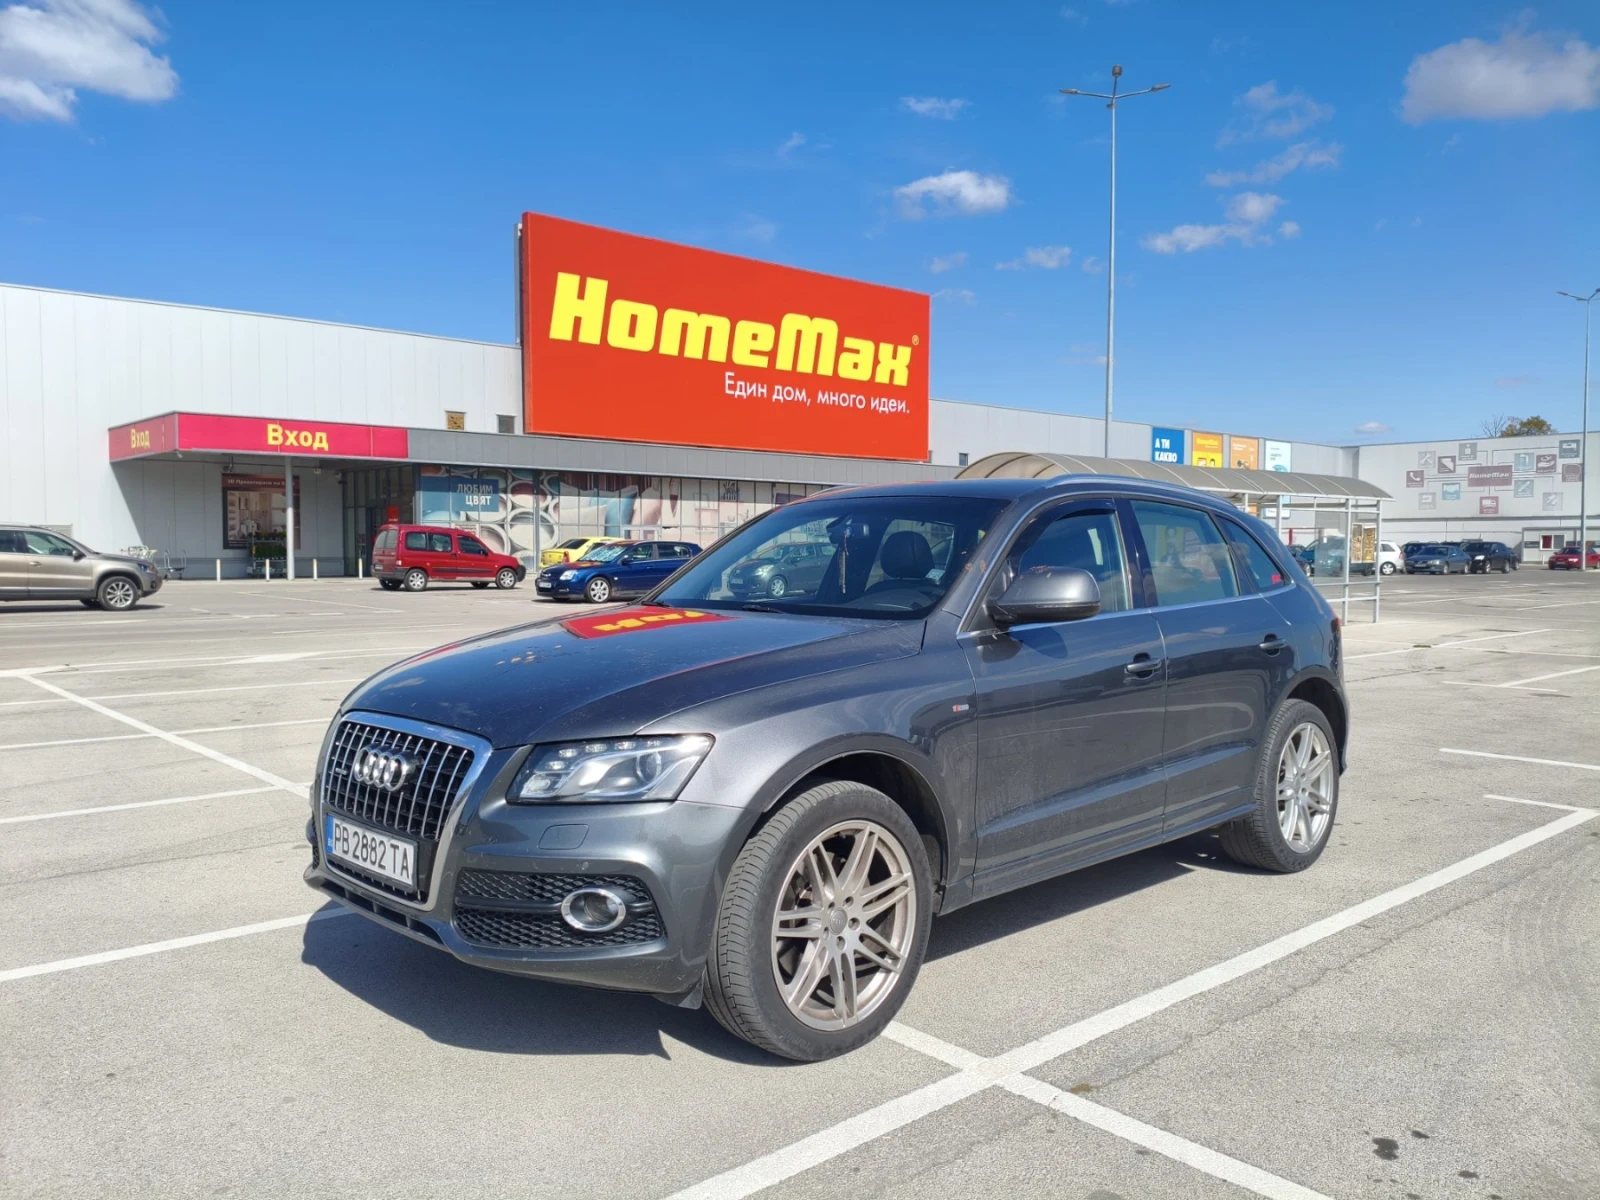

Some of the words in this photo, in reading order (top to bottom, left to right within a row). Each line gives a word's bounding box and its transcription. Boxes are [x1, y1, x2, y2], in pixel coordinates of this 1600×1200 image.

[725, 371, 767, 398] Един
[772, 385, 811, 406] дом,
[817, 390, 866, 409] много
[870, 397, 910, 414] идеи.
[131, 428, 150, 449] Вход
[267, 423, 329, 451] Вход
[1154, 450, 1178, 463] КАКВО
[457, 483, 493, 495] ЛЮБИМ
[465, 495, 492, 507] ЦВЯТ
[334, 823, 349, 855] PB
[352, 830, 387, 870] 2882
[390, 843, 410, 879] TA
